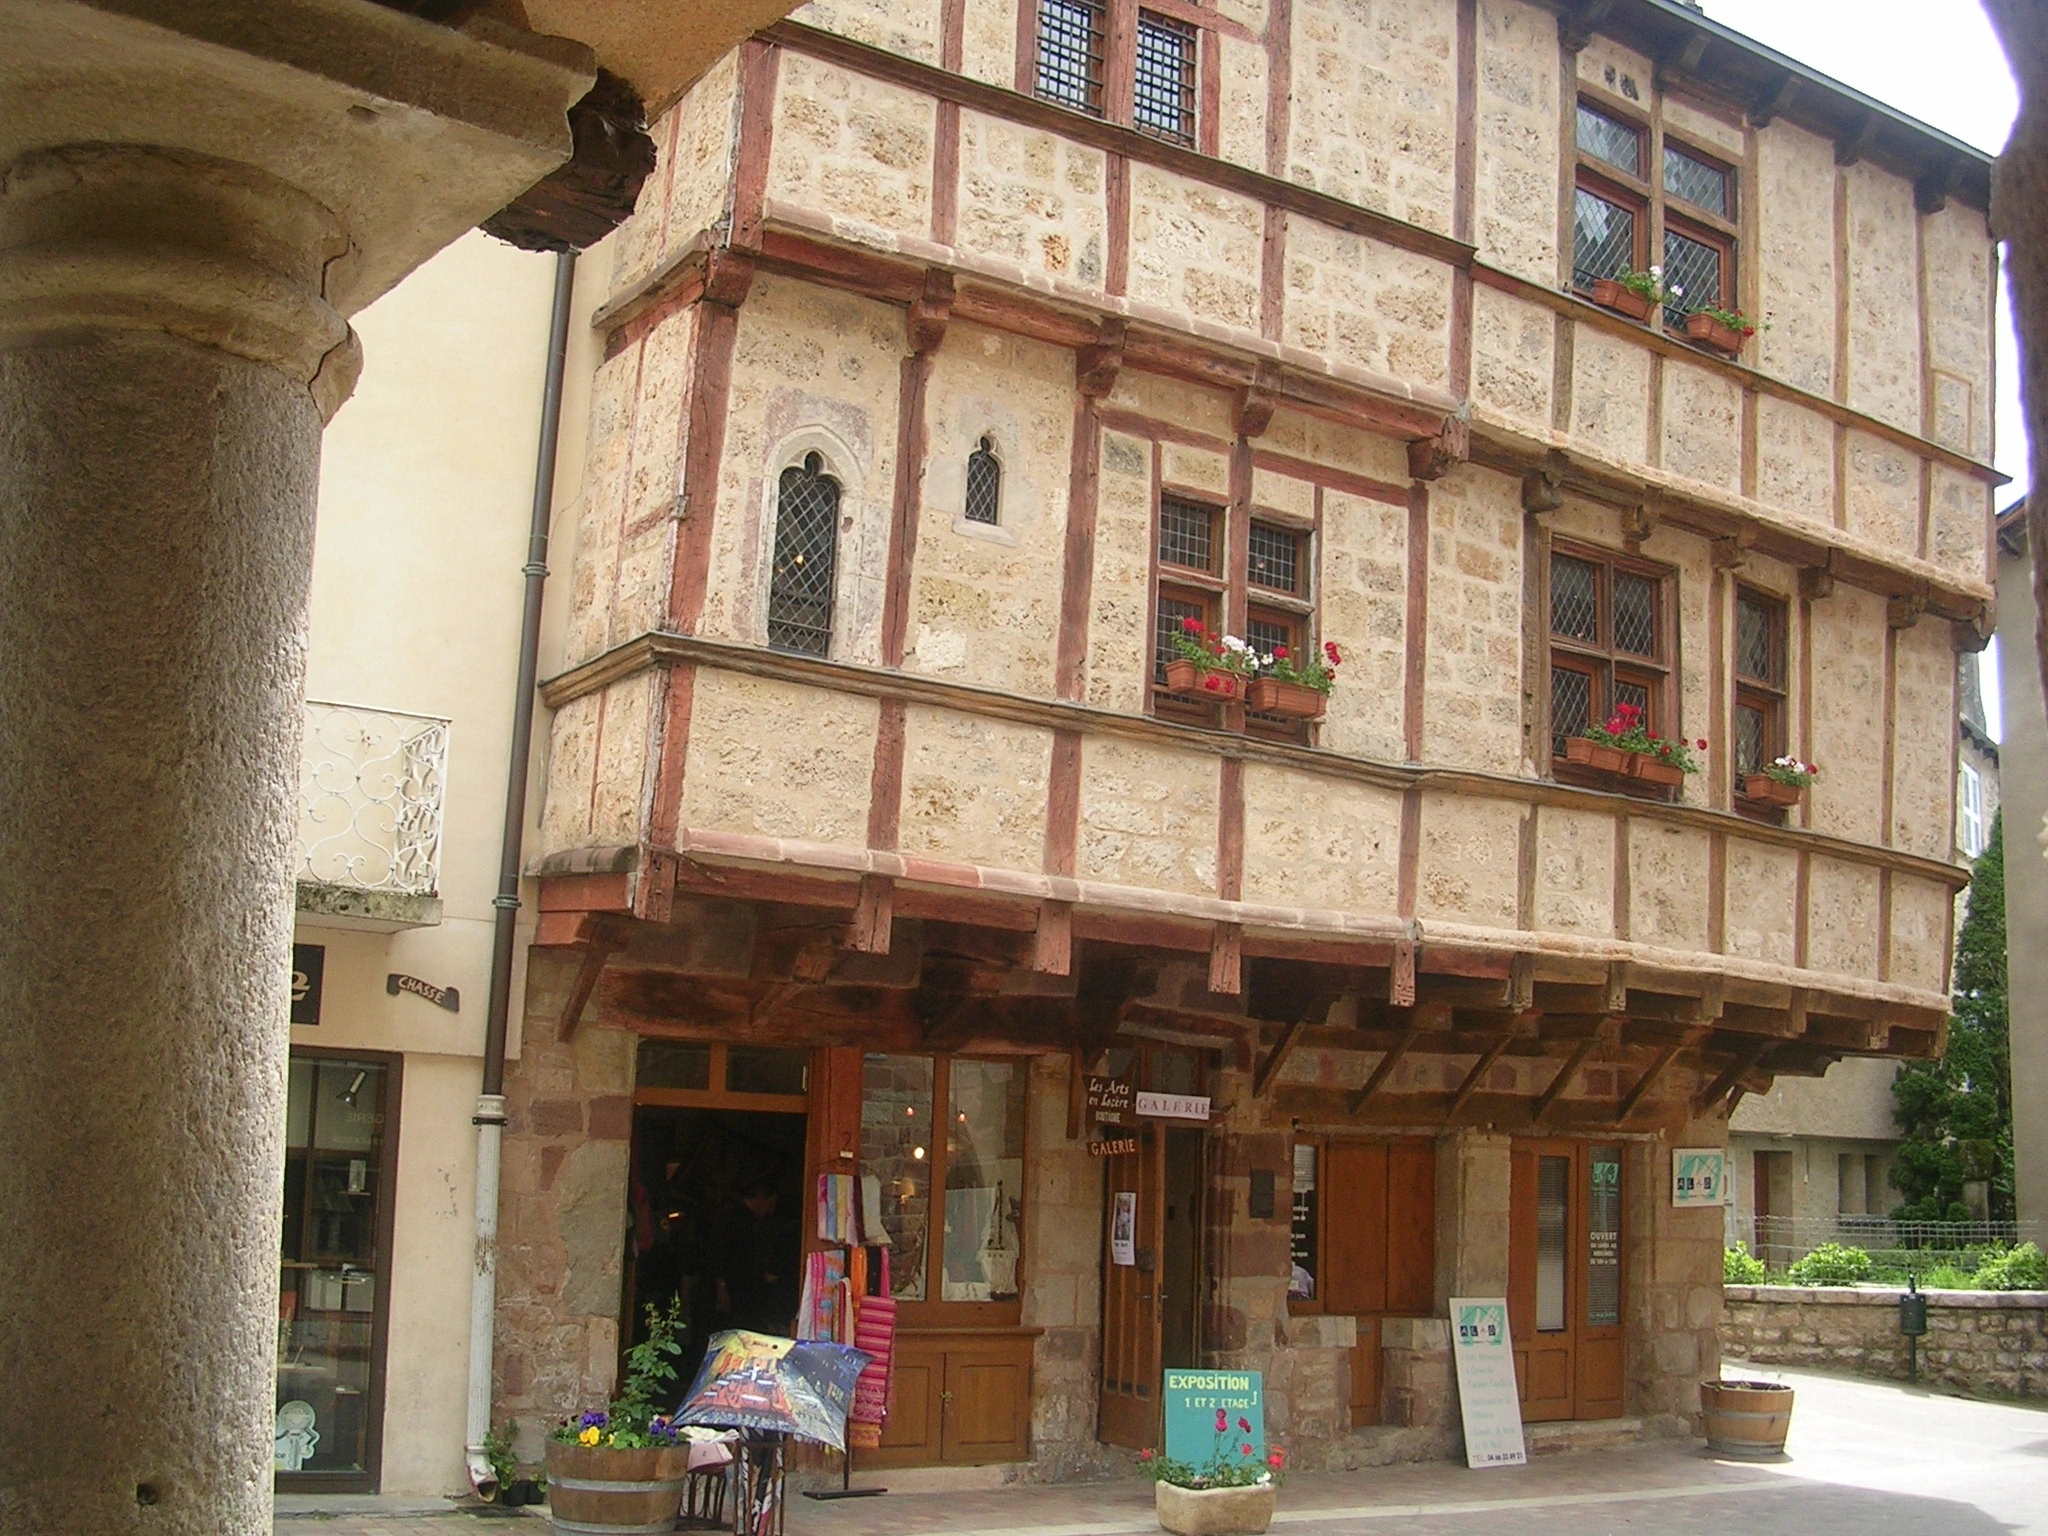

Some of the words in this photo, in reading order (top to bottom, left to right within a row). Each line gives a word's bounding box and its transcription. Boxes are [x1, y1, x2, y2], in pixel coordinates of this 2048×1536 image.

[398, 976, 446, 1004] CHASSE
[1089, 1078, 1103, 1092] Les
[1106, 1081, 1129, 1095] Arts
[1089, 1097, 1098, 1106] en
[1101, 1094, 1128, 1109] Lozère
[1138, 1098, 1209, 1115] GALERIE
[1091, 1138, 1136, 1156] GALERIE
[1590, 1231, 1617, 1241] OUVERT
[1168, 1373, 1250, 1390] EXPOSITION
[1184, 1397, 1190, 1408] 1
[1194, 1397, 1206, 1408] ET
[1209, 1397, 1215, 1408] 2
[1221, 1398, 1250, 1409] ETAGE
